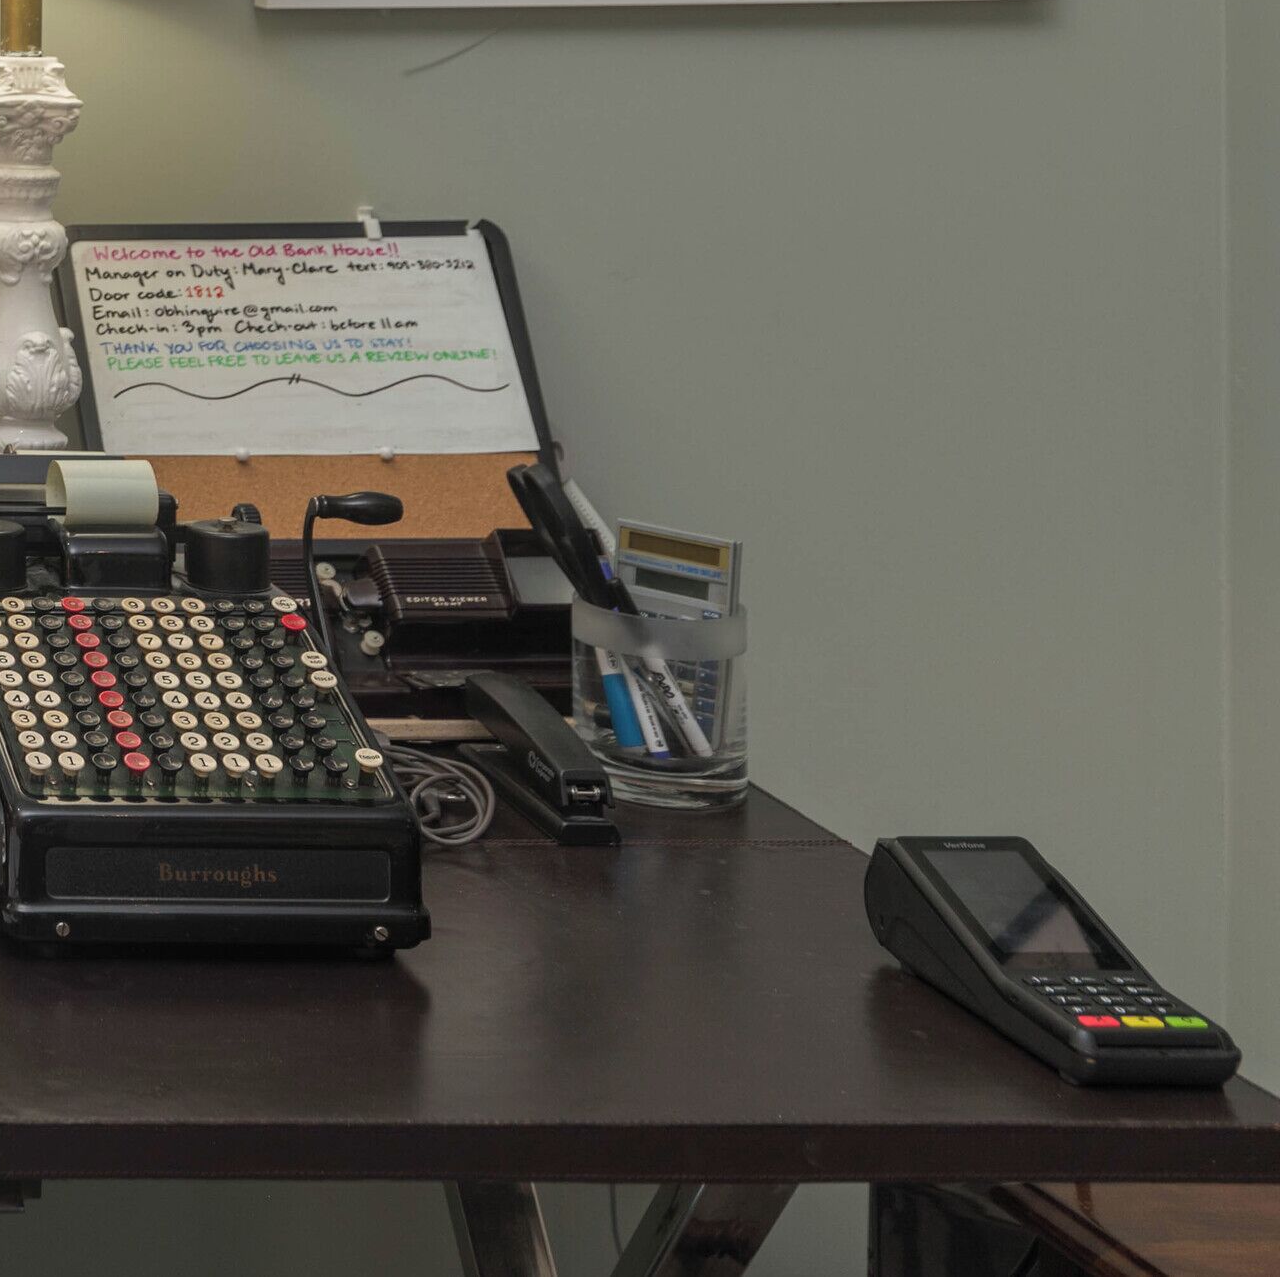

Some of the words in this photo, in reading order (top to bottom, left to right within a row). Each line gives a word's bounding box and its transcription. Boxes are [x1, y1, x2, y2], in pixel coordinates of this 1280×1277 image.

[93, 246, 182, 261] Welcome
[185, 247, 205, 259] to
[211, 246, 243, 258] the
[249, 244, 277, 256] Old
[283, 243, 327, 256] Bank
[333, 242, 400, 258] House!!
[85, 267, 158, 287] Manager
[167, 270, 185, 278] on
[89, 288, 130, 301] Door
[185, 285, 224, 298] 1812
[182, 321, 222, 338] 3pm
[331, 320, 375, 331] before
[100, 342, 158, 355] THANK
[164, 342, 192, 354] YOU
[199, 340, 227, 353] FOR
[234, 339, 317, 352] CHOOSING
[324, 338, 340, 350] US
[345, 338, 364, 348] TO
[107, 356, 163, 371] PLEASE
[169, 356, 204, 369] FEEL
[208, 354, 246, 368] FREE
[252, 354, 270, 365] TO
[276, 352, 320, 365] LEAVE
[326, 354, 345, 364] US
[349, 353, 360, 362] A
[365, 351, 429, 362] REVIEW
[160, 861, 278, 888] Burroughs
